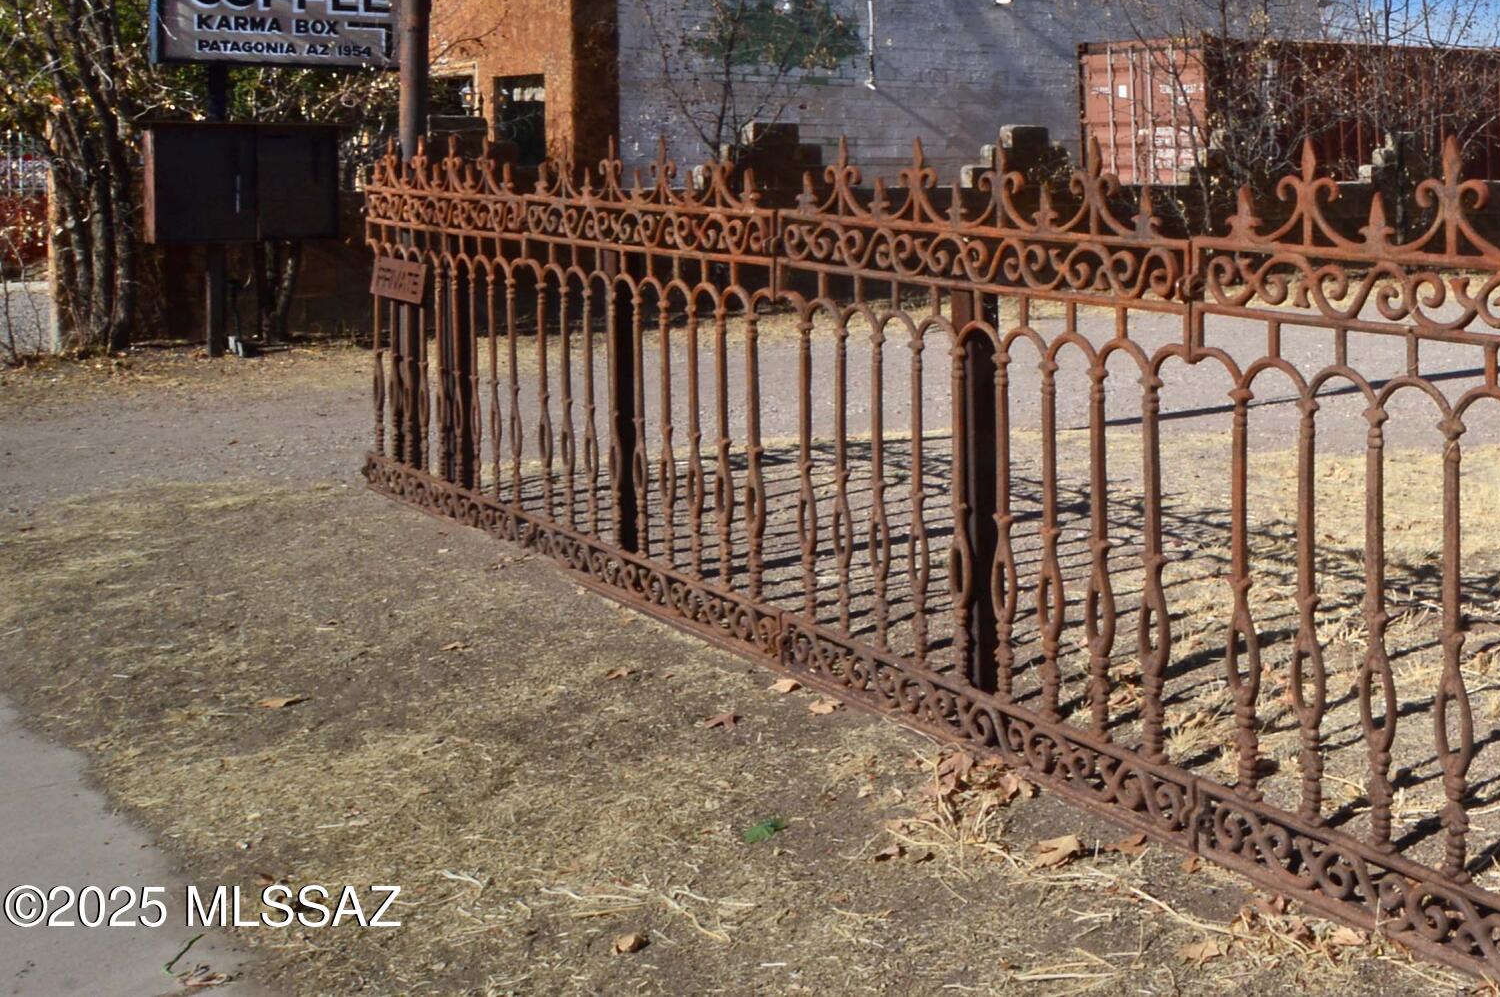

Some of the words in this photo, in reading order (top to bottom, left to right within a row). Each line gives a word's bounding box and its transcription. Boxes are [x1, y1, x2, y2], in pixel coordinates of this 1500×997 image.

[194, 14, 282, 33] KARMA
[292, 19, 340, 36] BOX
[306, 44, 330, 57] AZ
[337, 45, 372, 58] 1954
[376, 266, 420, 295] PRIVATE
